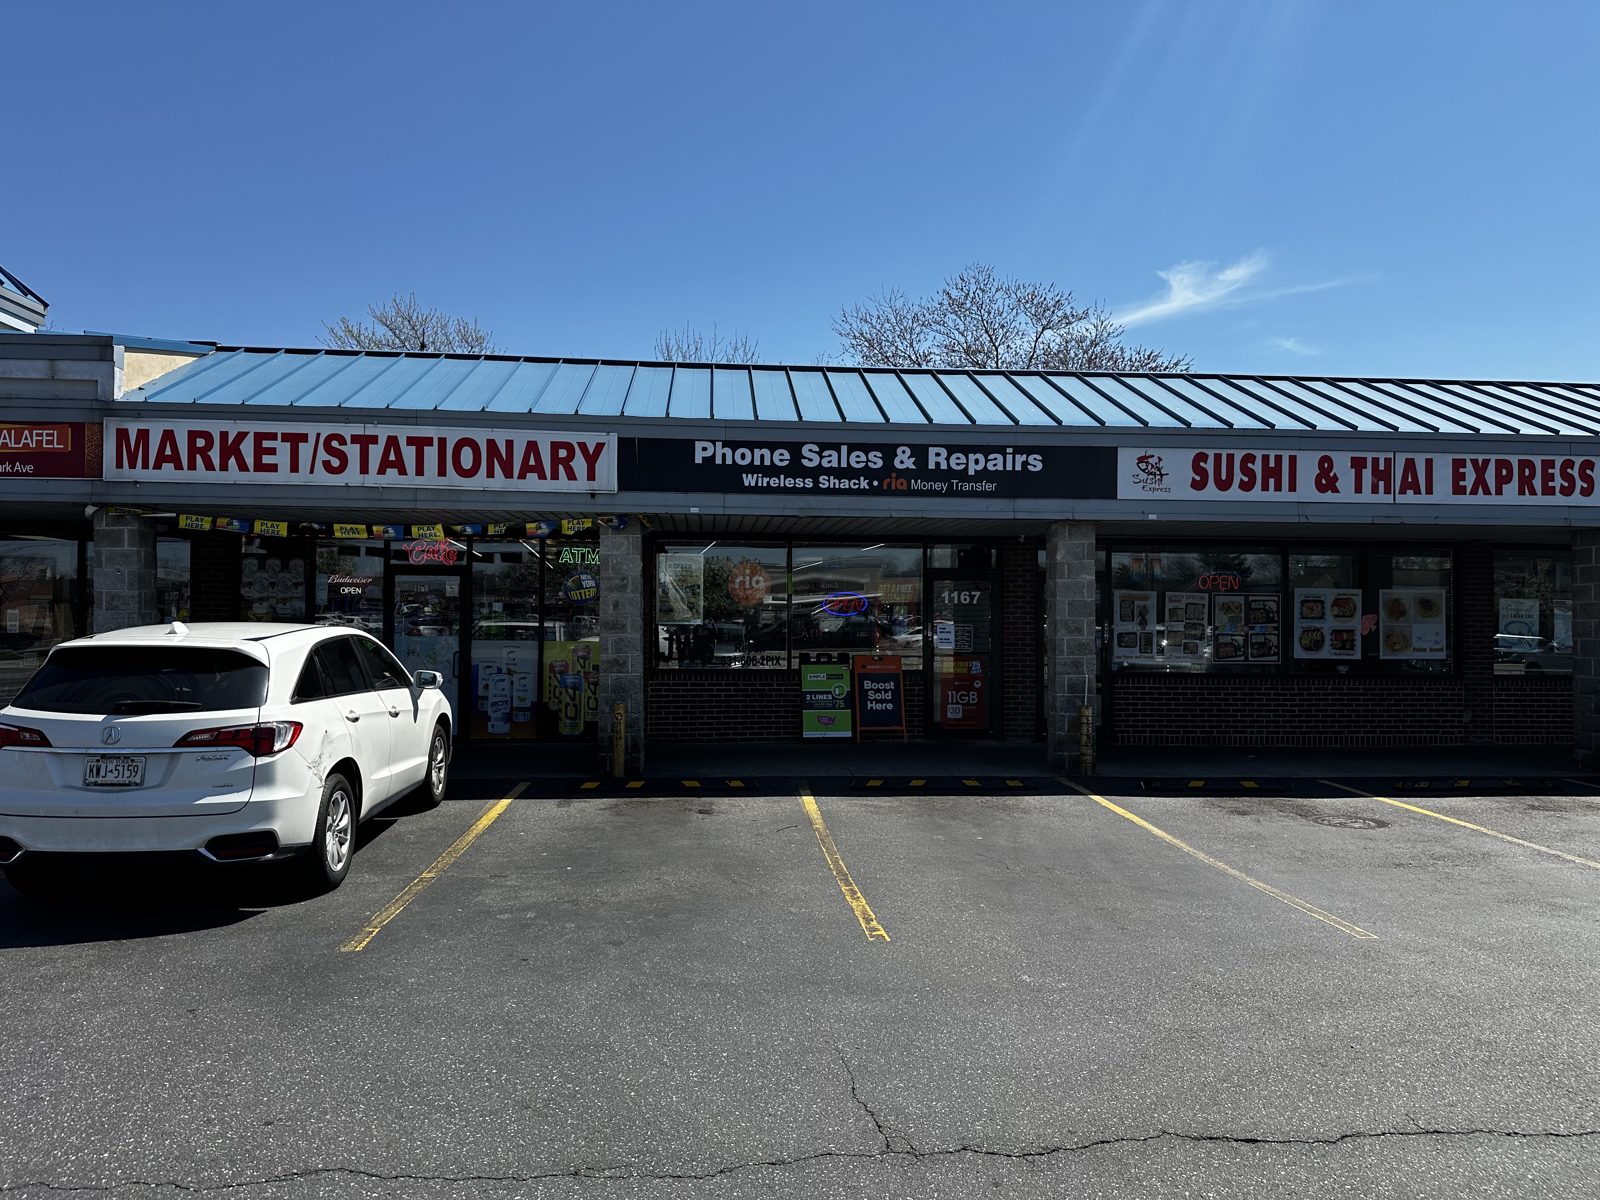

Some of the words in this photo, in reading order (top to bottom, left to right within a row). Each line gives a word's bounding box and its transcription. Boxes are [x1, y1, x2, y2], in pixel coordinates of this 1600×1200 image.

[0, 429, 64, 448] ALAFEL
[115, 427, 606, 481] MARKET/STATIONARY
[694, 440, 791, 466] Phone
[800, 443, 884, 469] Sales
[893, 445, 917, 470] &
[927, 446, 1044, 475] Repairs
[13, 461, 34, 473] Ave
[1190, 451, 1297, 492] SUSHI
[1314, 454, 1341, 494] &
[1350, 456, 1434, 495] THAI
[1452, 457, 1596, 497] EXPRESS
[742, 473, 814, 488] Wireless
[818, 475, 870, 489] Shack
[882, 472, 908, 490] ria
[911, 479, 948, 493] Money
[951, 479, 998, 492] Transfer
[185, 515, 206, 523] PLAY
[260, 521, 281, 530] PLAY
[417, 525, 436, 533] PLAY
[559, 547, 600, 564] ATM
[327, 574, 373, 584] Budweiser
[734, 569, 766, 590] ria
[1198, 575, 1241, 591] OPEN
[340, 586, 362, 595] OPEN
[941, 590, 982, 605] 1167
[863, 680, 895, 690] Boost
[867, 690, 892, 700] Sold
[947, 690, 978, 705] 11GB
[867, 700, 894, 710] Here
